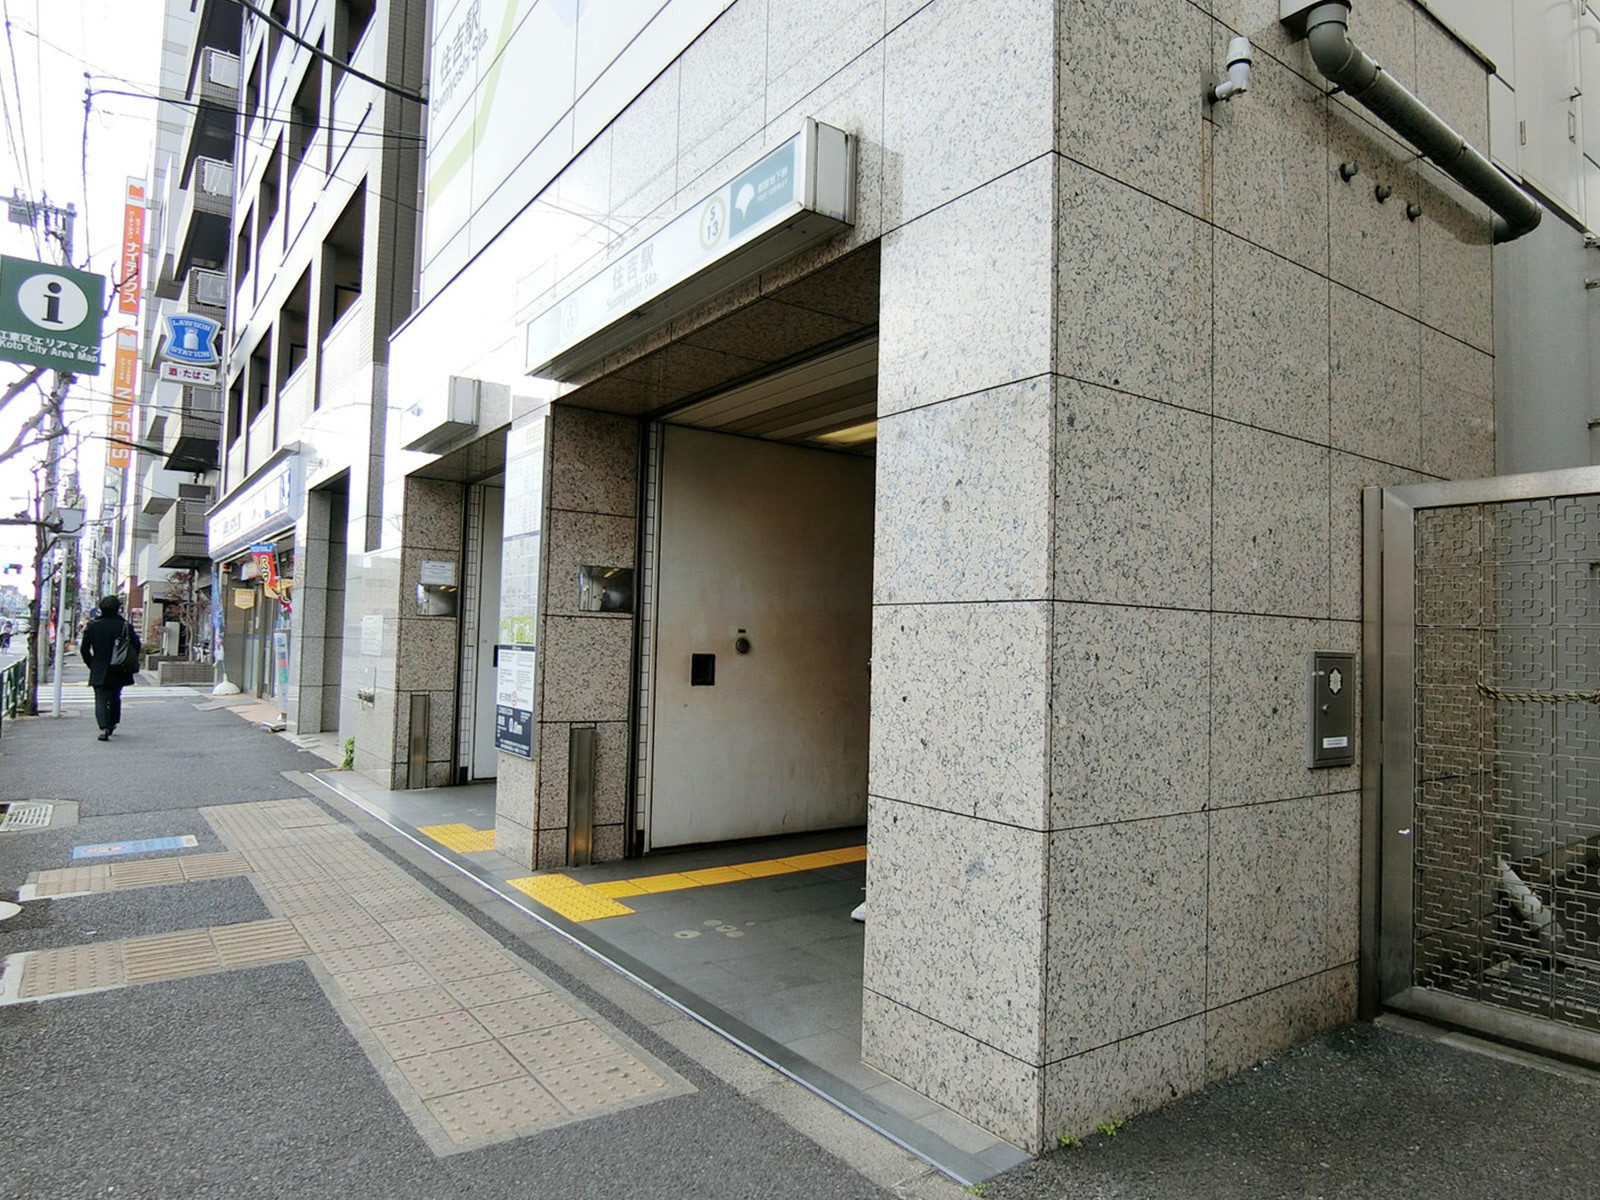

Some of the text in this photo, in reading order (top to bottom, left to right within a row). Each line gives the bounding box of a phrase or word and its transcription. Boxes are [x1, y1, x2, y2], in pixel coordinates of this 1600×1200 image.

[440, 0, 479, 86] 住吉駅
[709, 206, 716, 221] S
[706, 221, 719, 241] 13
[612, 243, 654, 292] 住吉駅
[606, 272, 659, 313] Sumiyoshi Sta.
[172, 317, 212, 331] LAWSON
[0, 337, 98, 363] Koto City Area Map
[170, 347, 210, 358] STATION
